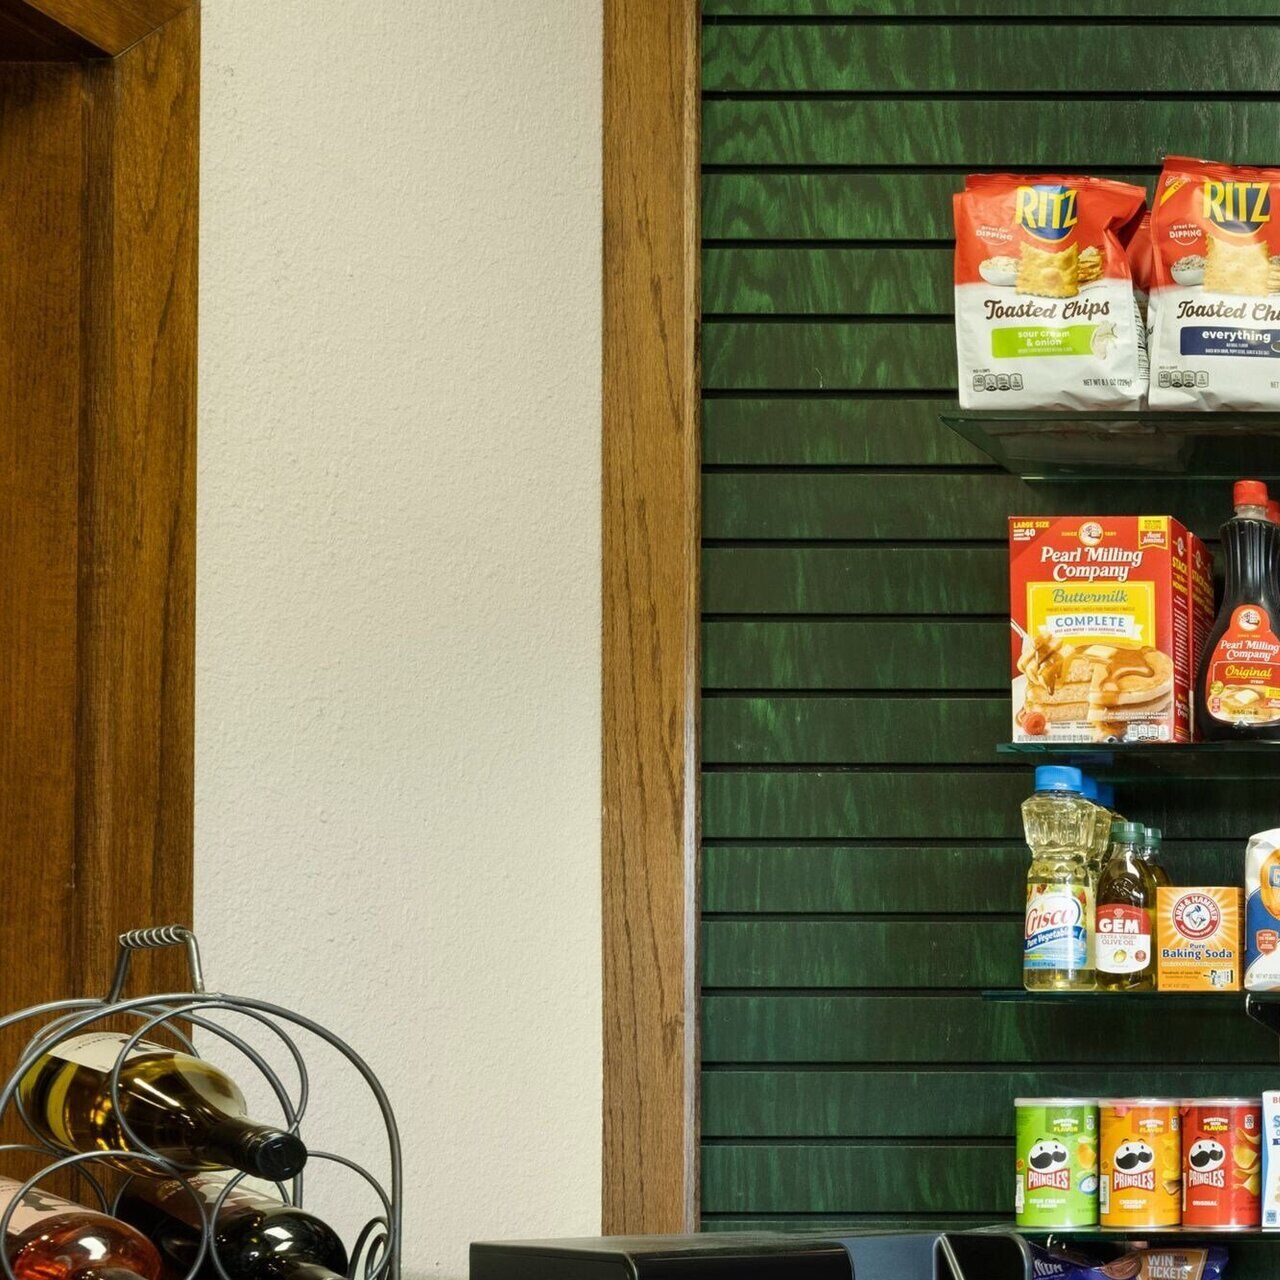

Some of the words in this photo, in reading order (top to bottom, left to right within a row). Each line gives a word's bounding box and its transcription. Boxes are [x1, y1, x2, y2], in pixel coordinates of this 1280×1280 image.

[1015, 185, 1078, 229] RITZ
[985, 298, 1058, 320] Toasted
[1063, 298, 1110, 320] Chips
[1202, 328, 1271, 344] everything
[1040, 547, 1083, 563] Pearl
[1088, 546, 1143, 567] Milling
[1053, 564, 1129, 582] Company
[1052, 589, 1127, 604] Buttermilk
[1055, 616, 1126, 627] COMPLETE
[1225, 666, 1271, 678] Original
[1100, 918, 1139, 932] GEM
[1162, 949, 1201, 961] Baking
[1205, 948, 1232, 959] Soda
[1028, 1172, 1067, 1188] PRINGLES
[1148, 1267, 1188, 1279] TICKETS
